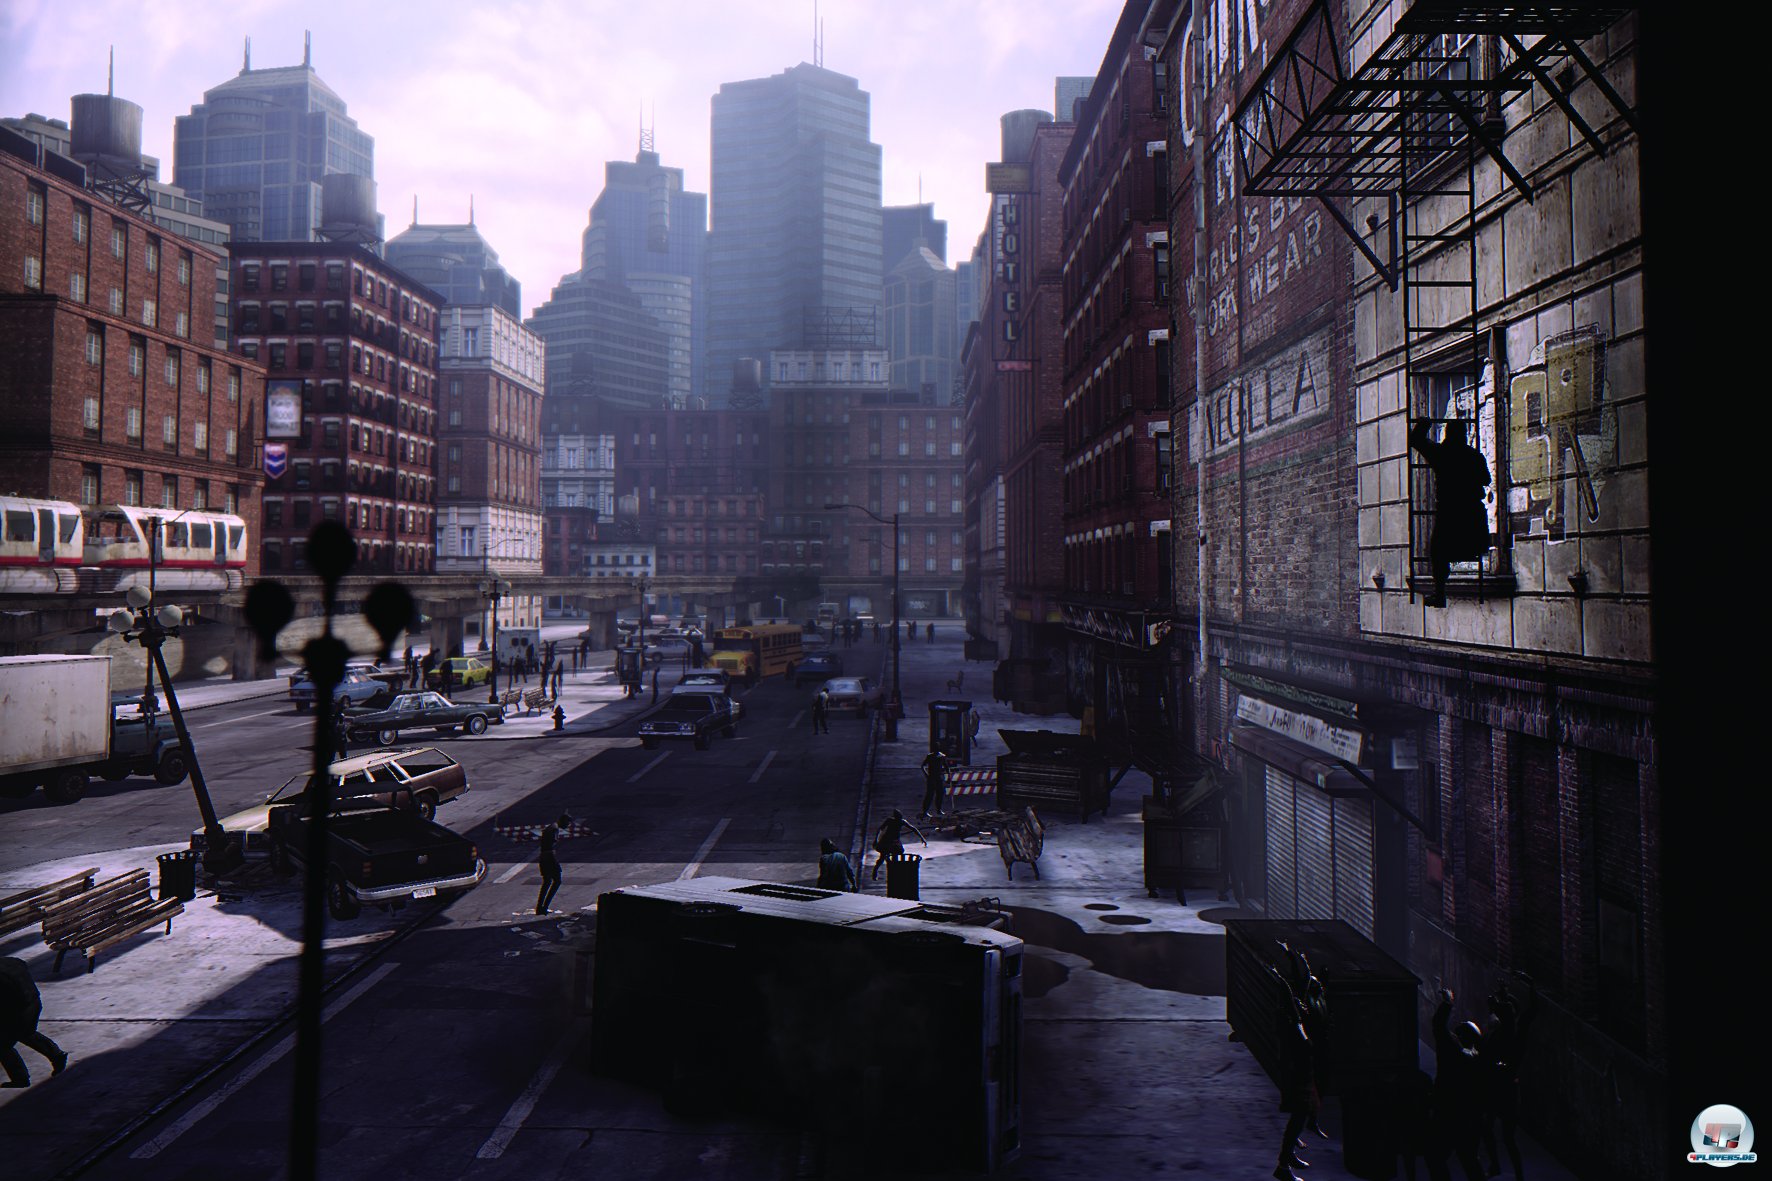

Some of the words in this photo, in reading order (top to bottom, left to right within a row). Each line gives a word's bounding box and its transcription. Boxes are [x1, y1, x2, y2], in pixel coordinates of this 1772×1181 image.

[1006, 207, 1017, 341] HOTEL
[1204, 277, 1239, 337] ORK
[1248, 209, 1323, 305] WEAR
